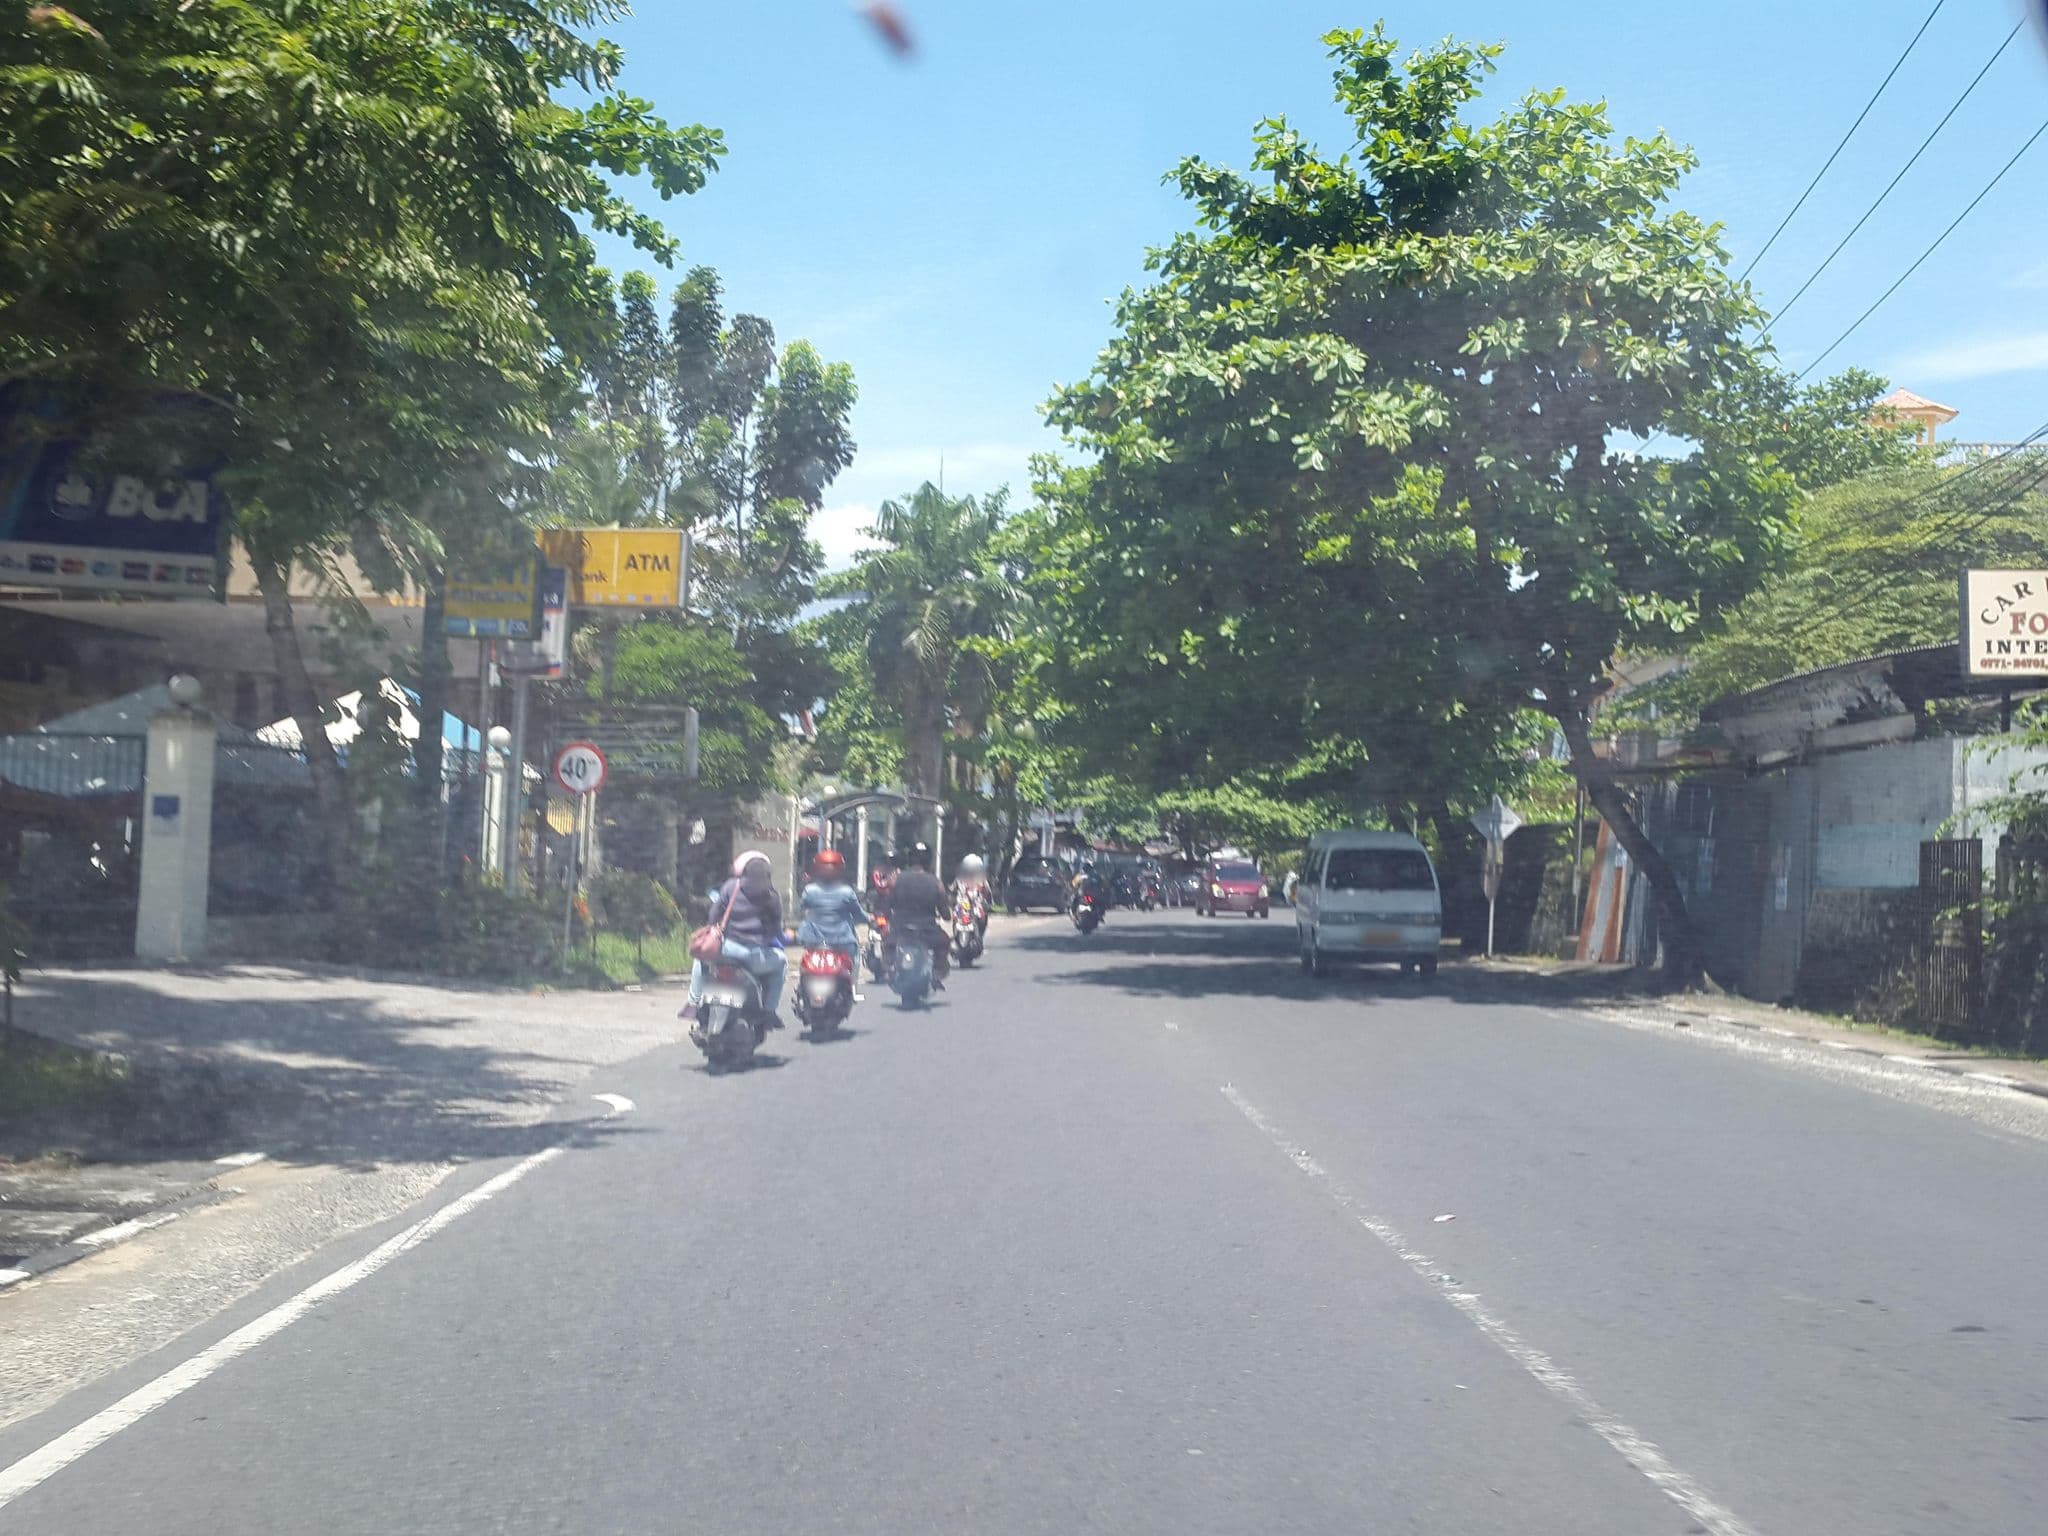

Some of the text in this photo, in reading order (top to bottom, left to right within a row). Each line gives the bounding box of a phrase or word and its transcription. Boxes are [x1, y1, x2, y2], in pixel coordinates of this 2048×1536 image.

[106, 475, 208, 523] BCA
[624, 552, 672, 572] ATM
[1981, 581, 2034, 625] CAR
[2009, 611, 2048, 635] FO
[561, 756, 587, 779] 40
